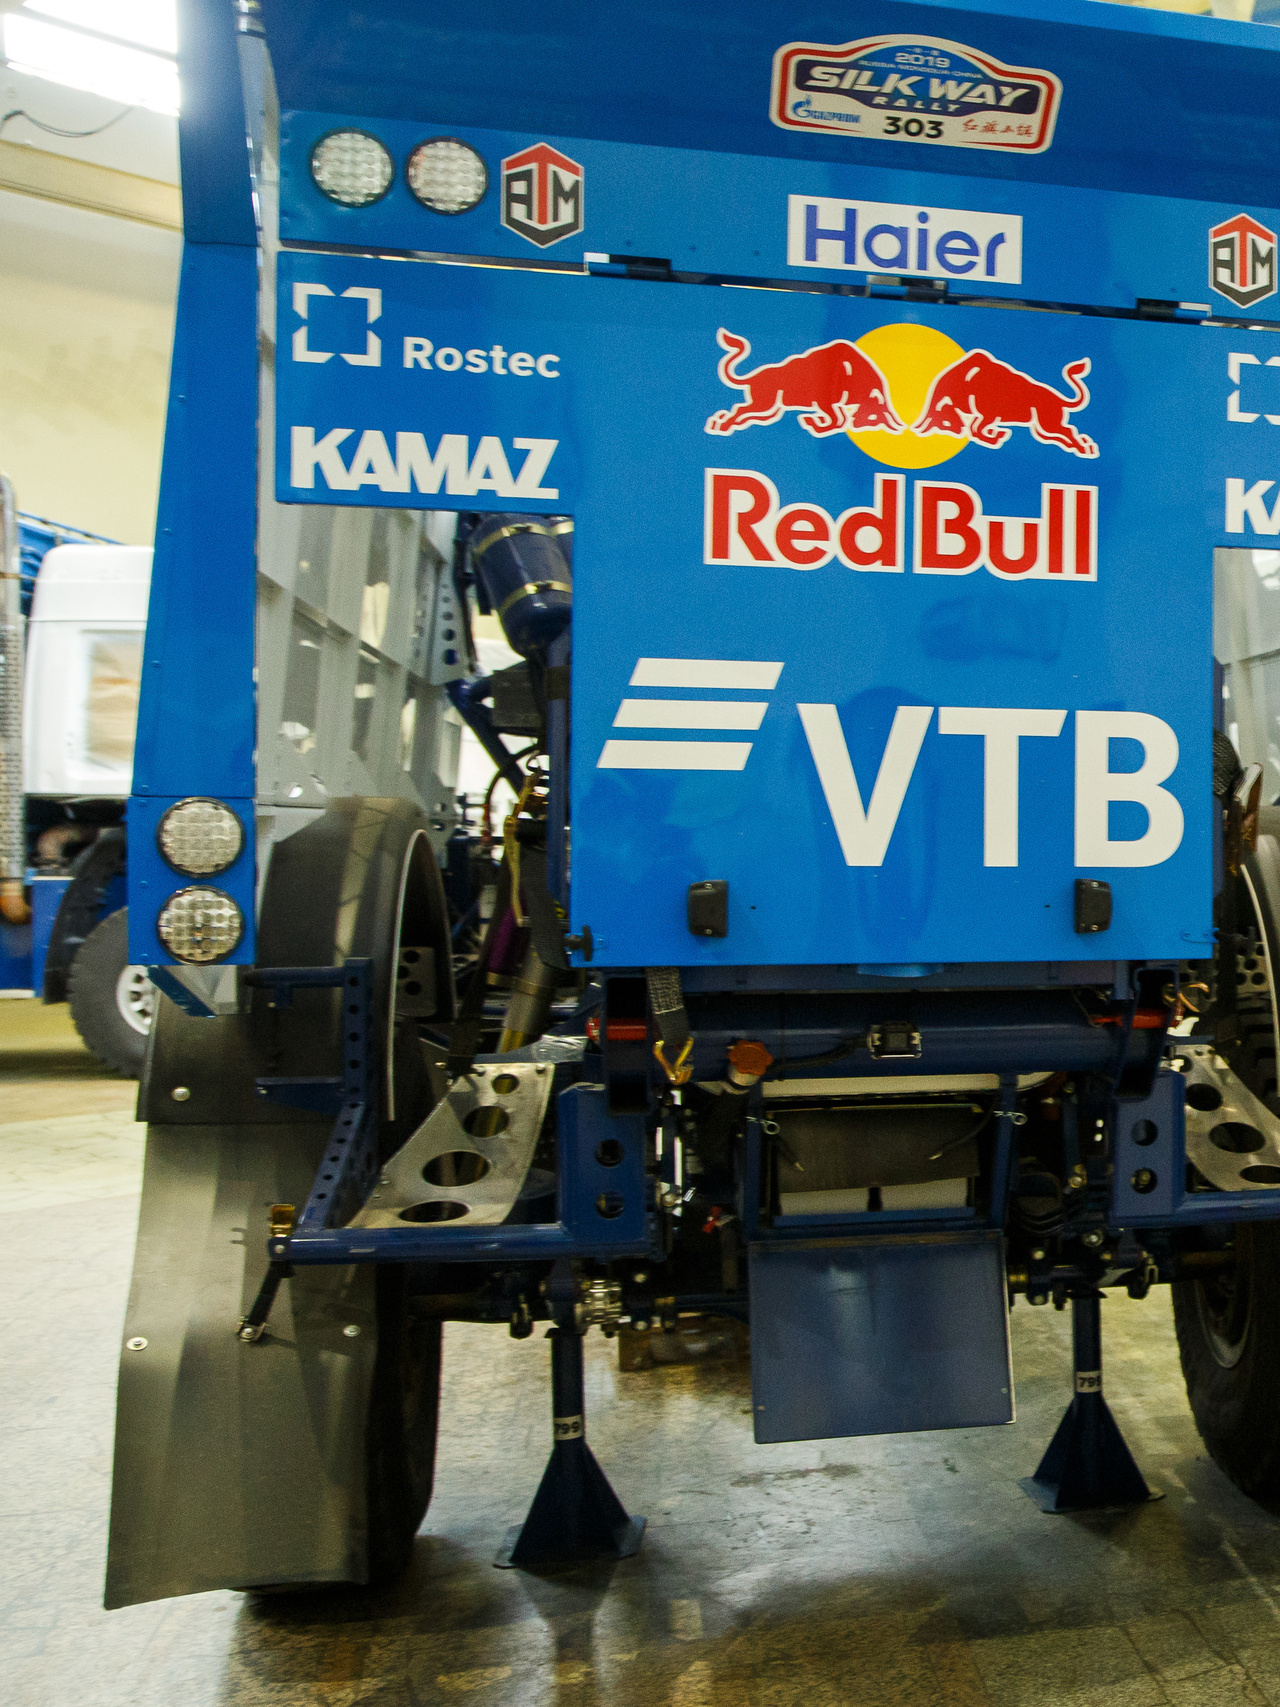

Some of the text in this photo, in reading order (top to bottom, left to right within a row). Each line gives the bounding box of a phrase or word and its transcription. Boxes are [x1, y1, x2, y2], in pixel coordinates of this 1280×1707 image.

[895, 52, 950, 68] 2019
[805, 65, 1029, 107] SILK WAY
[872, 96, 961, 112] RALLY
[883, 116, 943, 138] 303
[804, 204, 1006, 277] Haier
[403, 336, 560, 378] Rostec
[290, 426, 559, 499] KAMAZ
[705, 469, 1097, 580] Red Bull
[797, 703, 1185, 868] VTB
